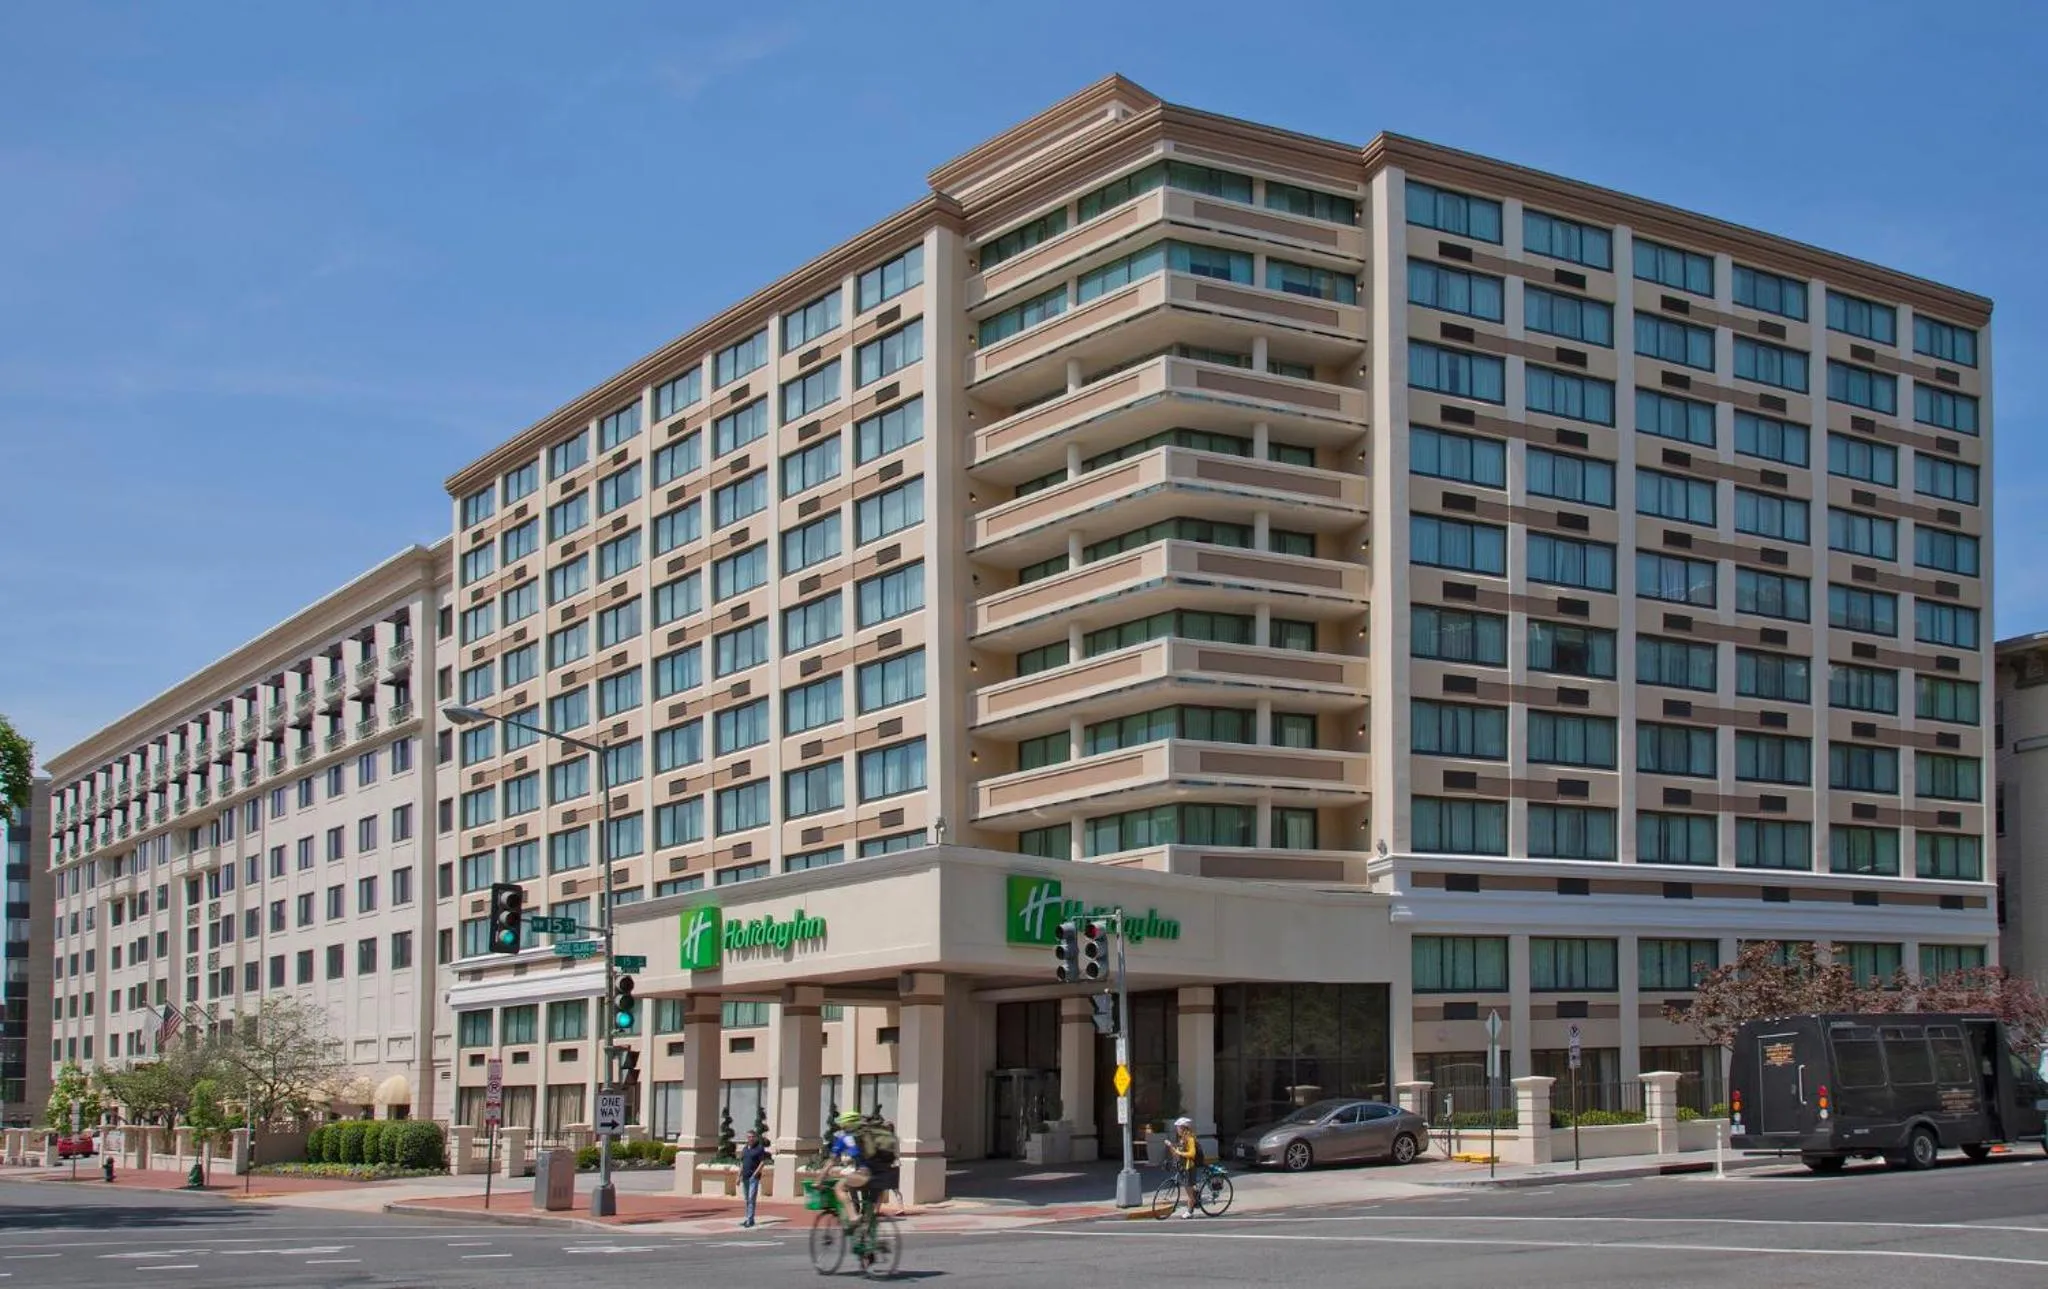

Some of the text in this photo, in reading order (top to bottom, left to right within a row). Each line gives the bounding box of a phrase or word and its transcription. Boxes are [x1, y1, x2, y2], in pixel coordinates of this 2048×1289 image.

[547, 919, 564, 933] 15
[723, 908, 827, 951] Holiday Inn
[1147, 906, 1181, 941] Inn
[601, 1097, 621, 1107] ONE
[600, 1107, 621, 1117] WAY
